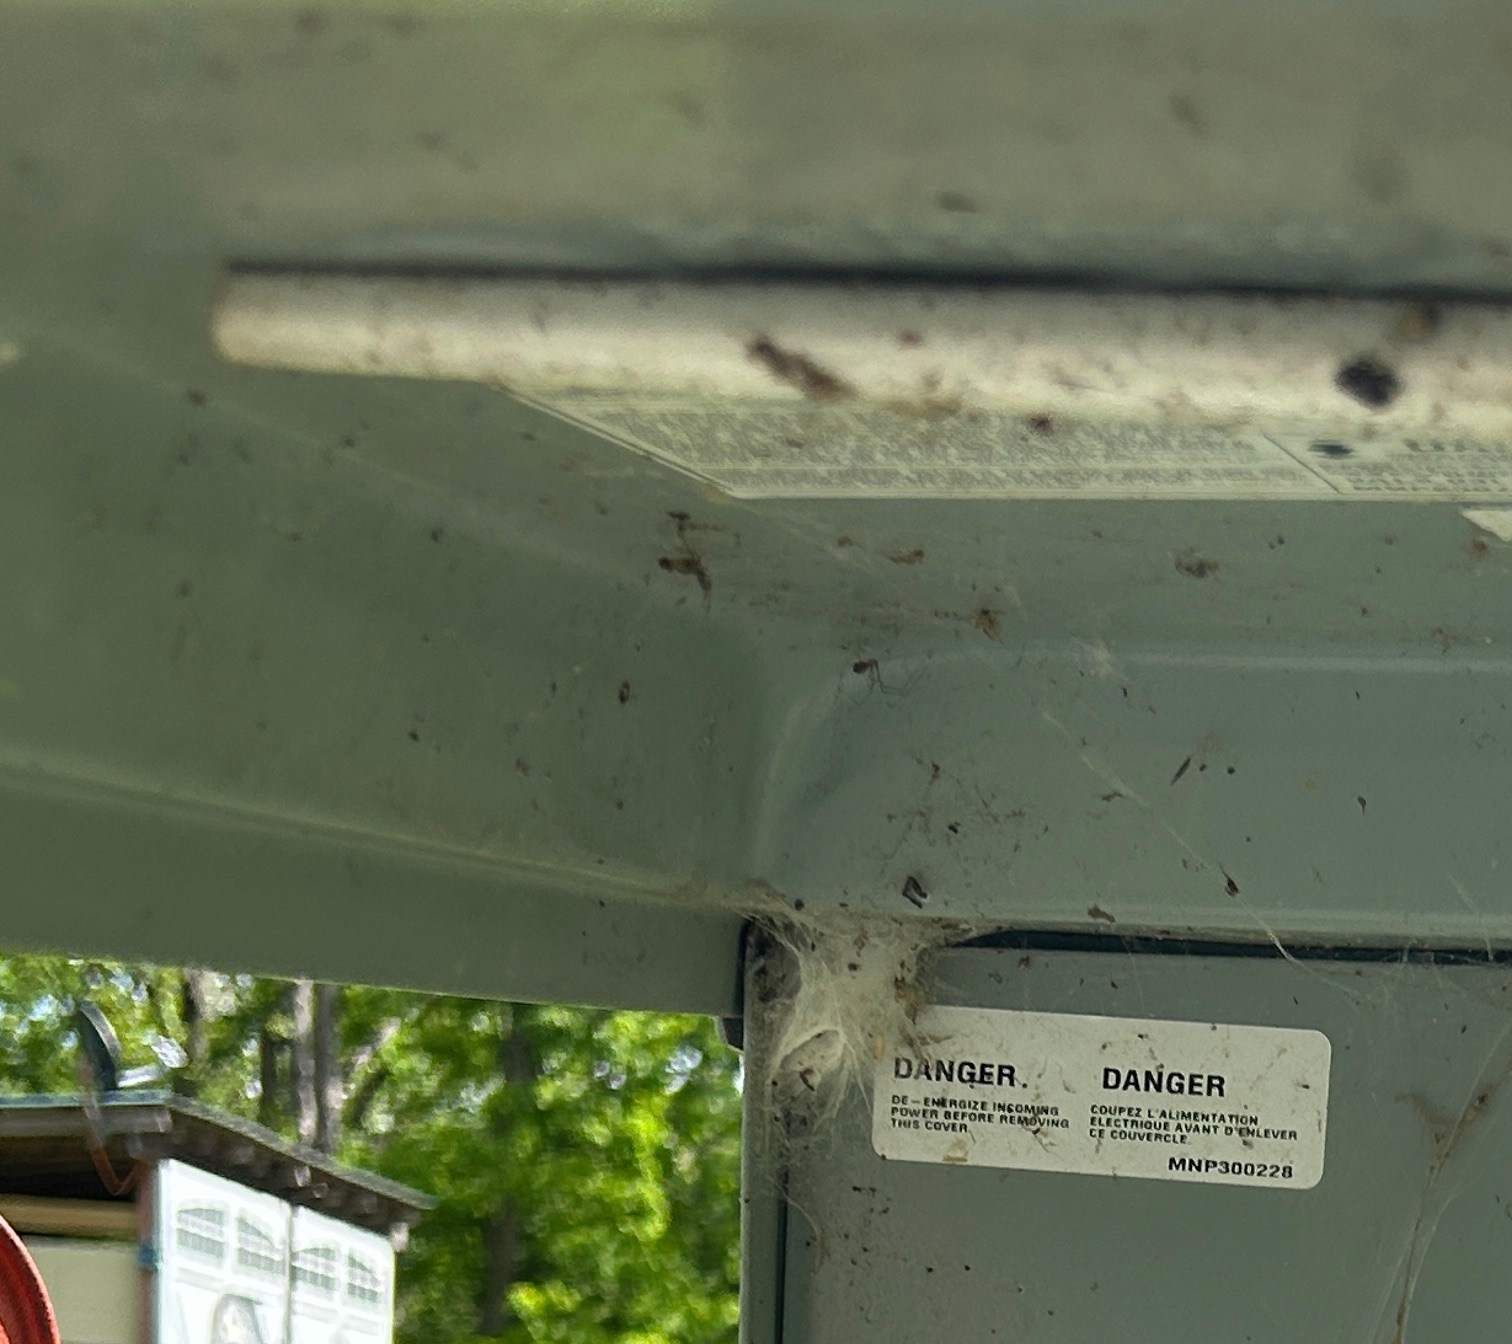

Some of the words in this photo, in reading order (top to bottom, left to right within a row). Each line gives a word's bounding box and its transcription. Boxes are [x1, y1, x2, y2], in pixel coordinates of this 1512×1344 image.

[893, 1056, 1016, 1087] DANGER
[1102, 1066, 1226, 1098] DANGER
[891, 1106, 938, 1121] POWER
[943, 1109, 995, 1124] BEFORE
[999, 1112, 1069, 1129] REMOVING
[891, 1117, 920, 1131] THIS
[1089, 1104, 1142, 1119] COUPEZ
[1146, 1107, 1259, 1126] L'ALIMENTATION
[1089, 1128, 1105, 1139] CE
[1174, 1121, 1219, 1135] AVANT
[1167, 1157, 1293, 1178] MNP300228
